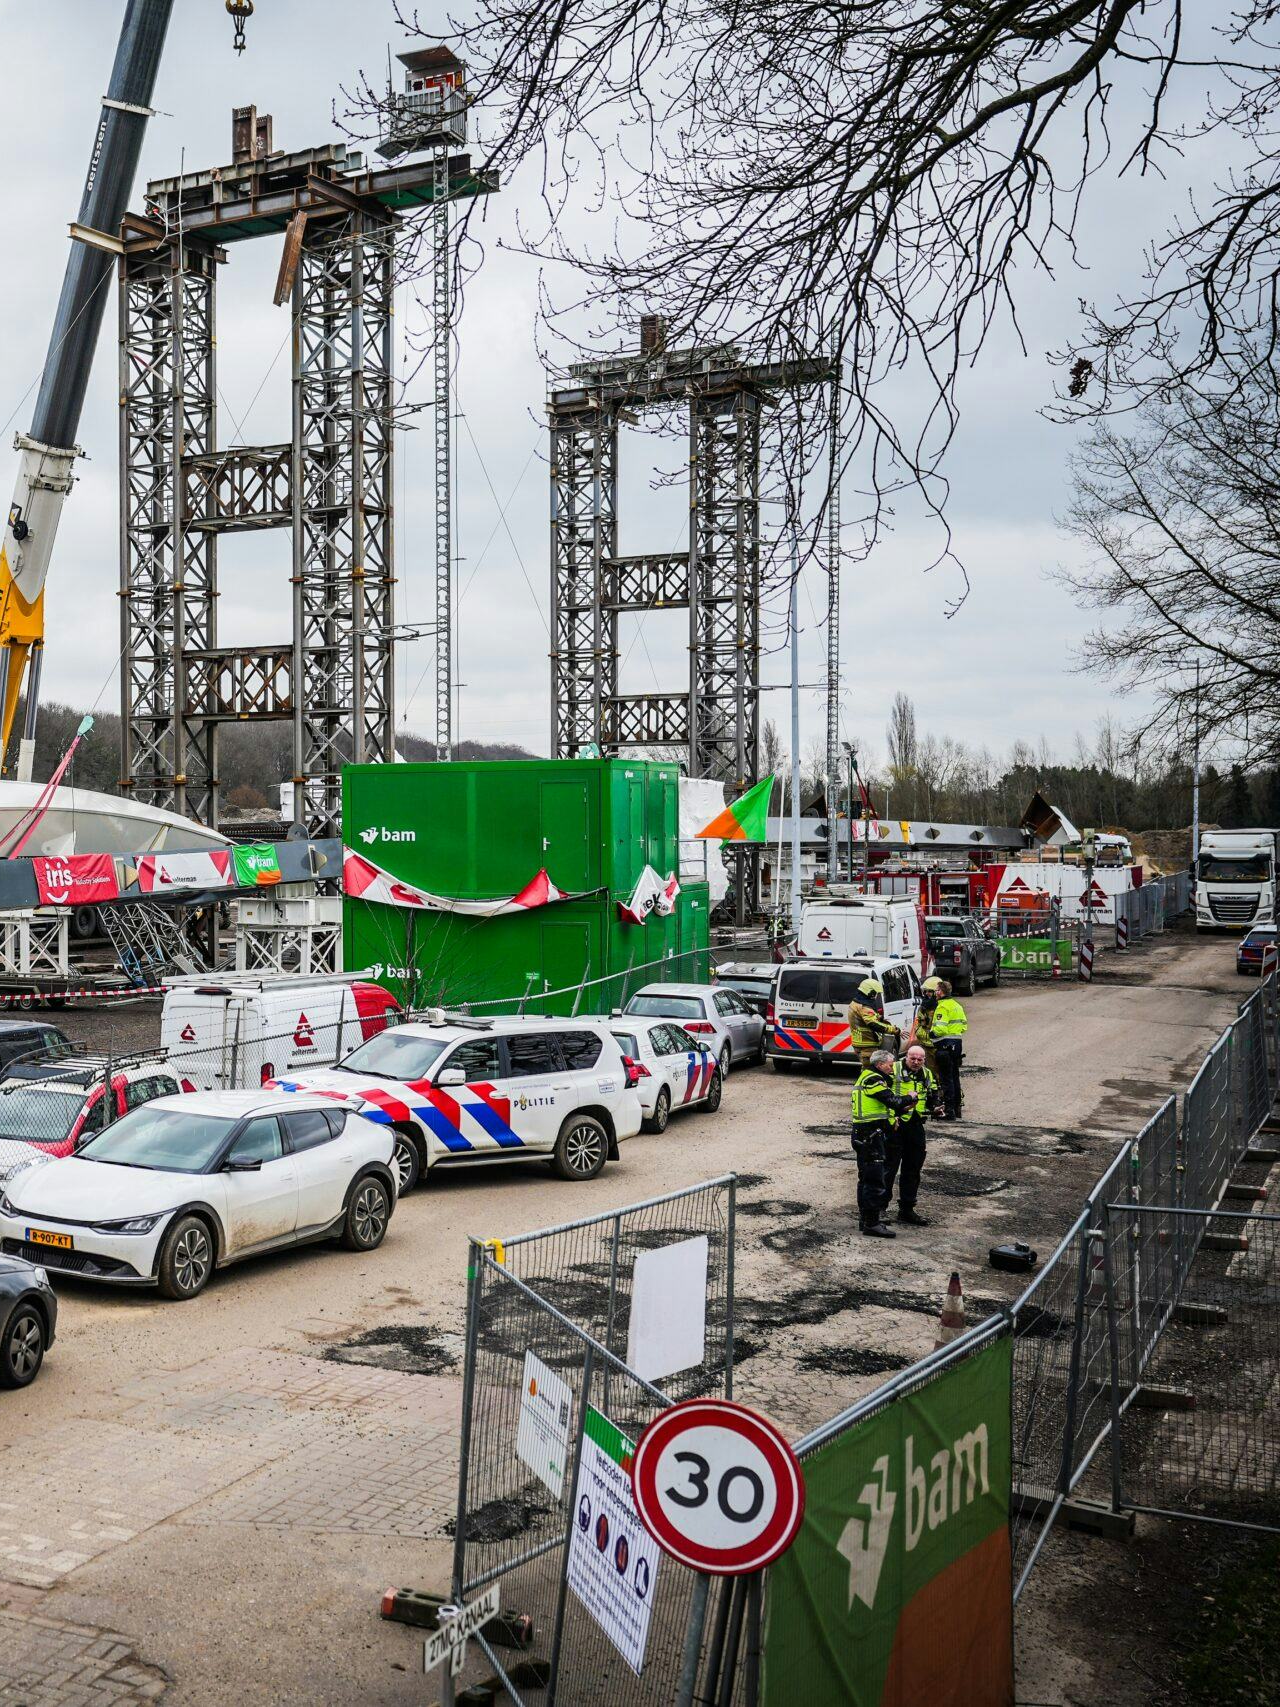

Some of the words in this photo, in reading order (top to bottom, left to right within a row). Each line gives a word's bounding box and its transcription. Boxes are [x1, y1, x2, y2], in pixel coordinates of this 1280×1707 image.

[86, 120, 108, 191] aertssen
[381, 827, 416, 842] bam
[45, 861, 73, 887] iris
[386, 964, 421, 980] bam
[514, 1096, 555, 1111] POLITIE
[32, 1232, 69, 1247] R-907-KT
[664, 1451, 765, 1525] 30
[905, 1423, 990, 1552] bam
[457, 1593, 495, 1640] KANAAL
